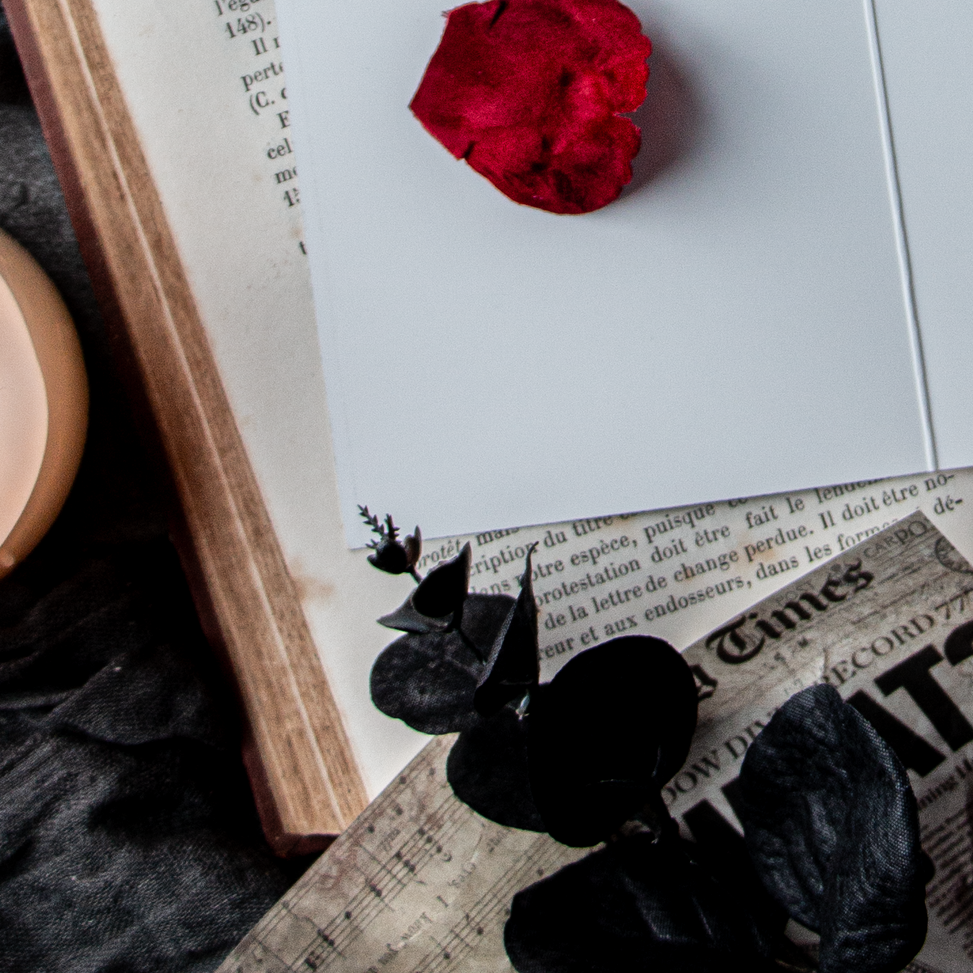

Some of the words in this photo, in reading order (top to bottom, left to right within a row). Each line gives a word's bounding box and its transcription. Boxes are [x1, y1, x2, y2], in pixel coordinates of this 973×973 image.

[225, 12, 272, 39] 148).
[543, 530, 567, 548] du
[544, 610, 567, 630] de
[570, 603, 589, 623] la
[591, 583, 642, 613] lettre
[645, 573, 668, 593] de
[673, 551, 740, 584] change
[744, 522, 814, 564] perdue.
[817, 510, 836, 530] Il
[842, 497, 880, 521] doit
[882, 486, 919, 508] être
[570, 532, 639, 566] espèce,
[643, 501, 716, 544] puisque
[650, 537, 688, 564] doit
[695, 524, 731, 548] être
[744, 507, 779, 530] fait
[786, 496, 806, 515] le
[580, 627, 600, 645] et
[604, 615, 639, 636] aux
[644, 573, 753, 622] endosseurs,
[755, 556, 800, 581] dans
[805, 542, 833, 564] les
[705, 559, 876, 665] Times
